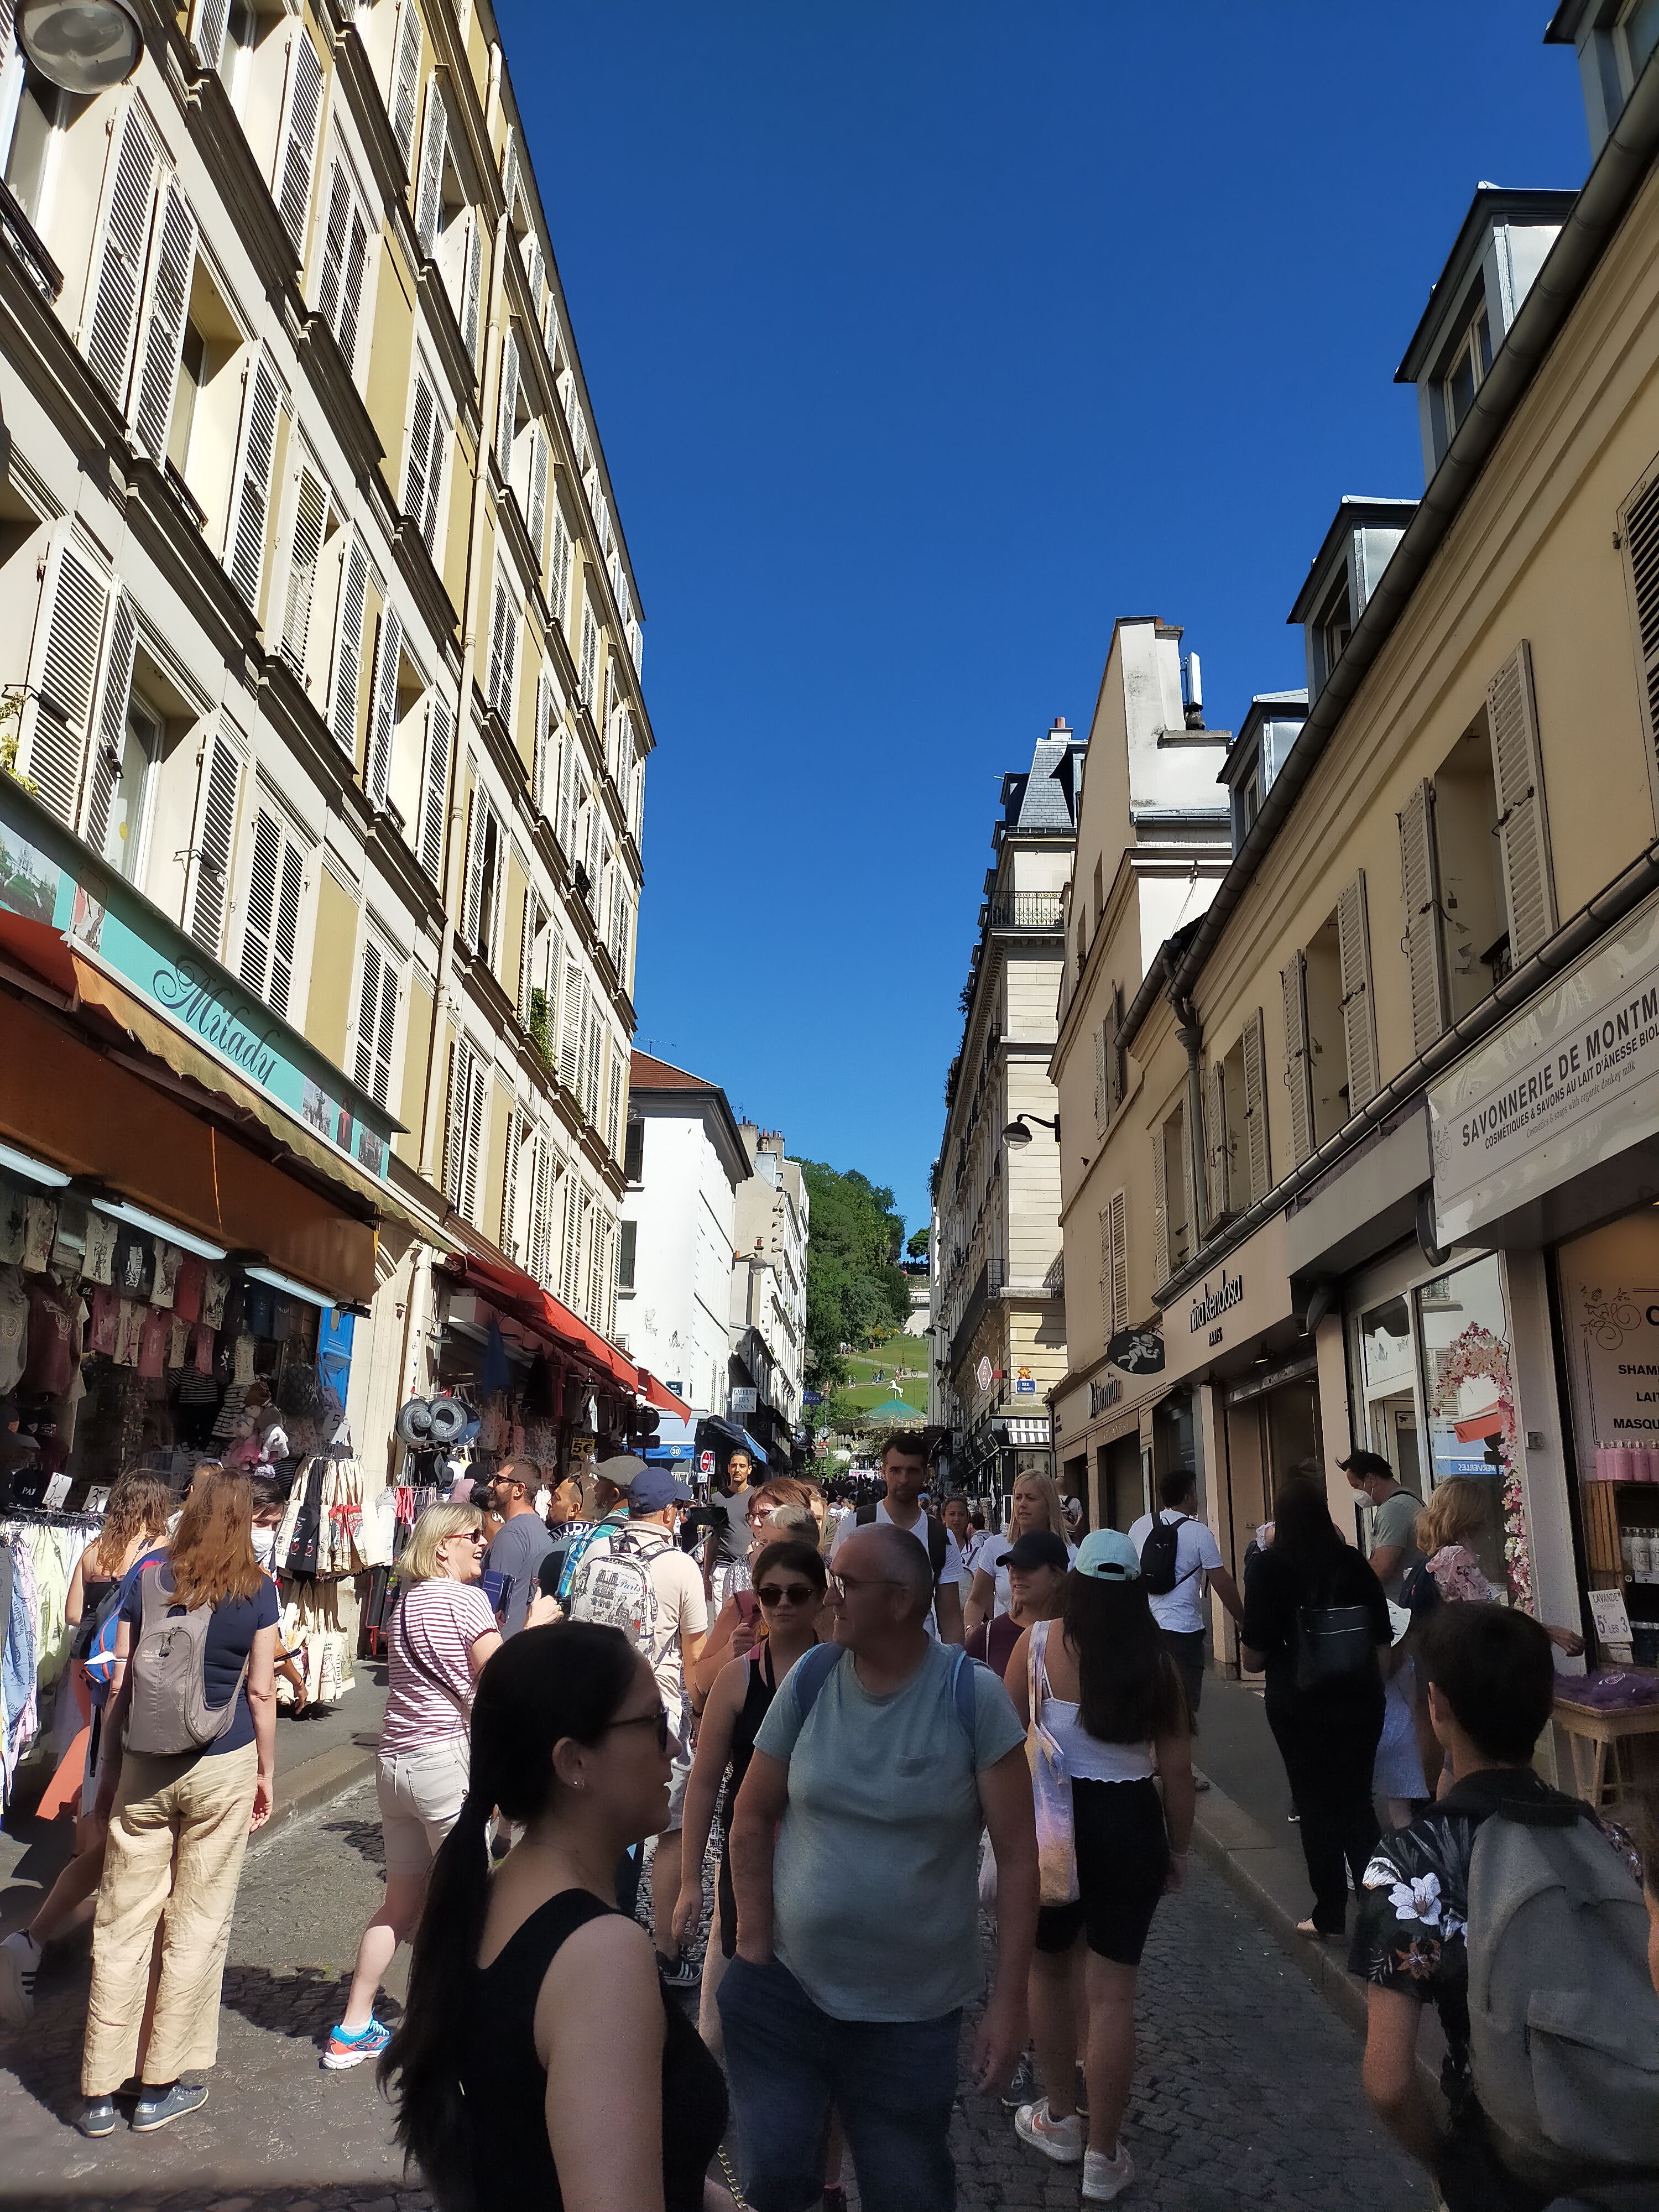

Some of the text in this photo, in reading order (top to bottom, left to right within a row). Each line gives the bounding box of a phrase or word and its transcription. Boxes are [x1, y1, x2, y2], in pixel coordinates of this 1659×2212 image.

[153, 954, 281, 1086] Milady
[1462, 1064, 1554, 1147] SAVONNERIE
[1558, 1044, 1581, 1081] DE
[1485, 1112, 1530, 1150] COSMÉTIQUES
[1531, 1108, 1536, 1119] &
[1537, 1087, 1565, 1117] SAVONS
[1567, 1080, 1577, 1096] AU
[1578, 1066, 1594, 1088] LAIT
[1595, 1037, 1638, 1076] D'ÂNESSE
[1526, 1117, 1549, 1138] Cosmetics
[1554, 1106, 1568, 1122] soaps
[1568, 1096, 1580, 1110] with
[1580, 1084, 1600, 1103] organic
[1601, 1070, 1621, 1089] donkey
[1623, 1060, 1636, 1077] milk
[1618, 1364, 1659, 1375] SHAM
[573, 1442, 593, 1453] 5€
[618, 1579, 640, 1592] Paris
[1620, 1616, 1628, 1634] 3
